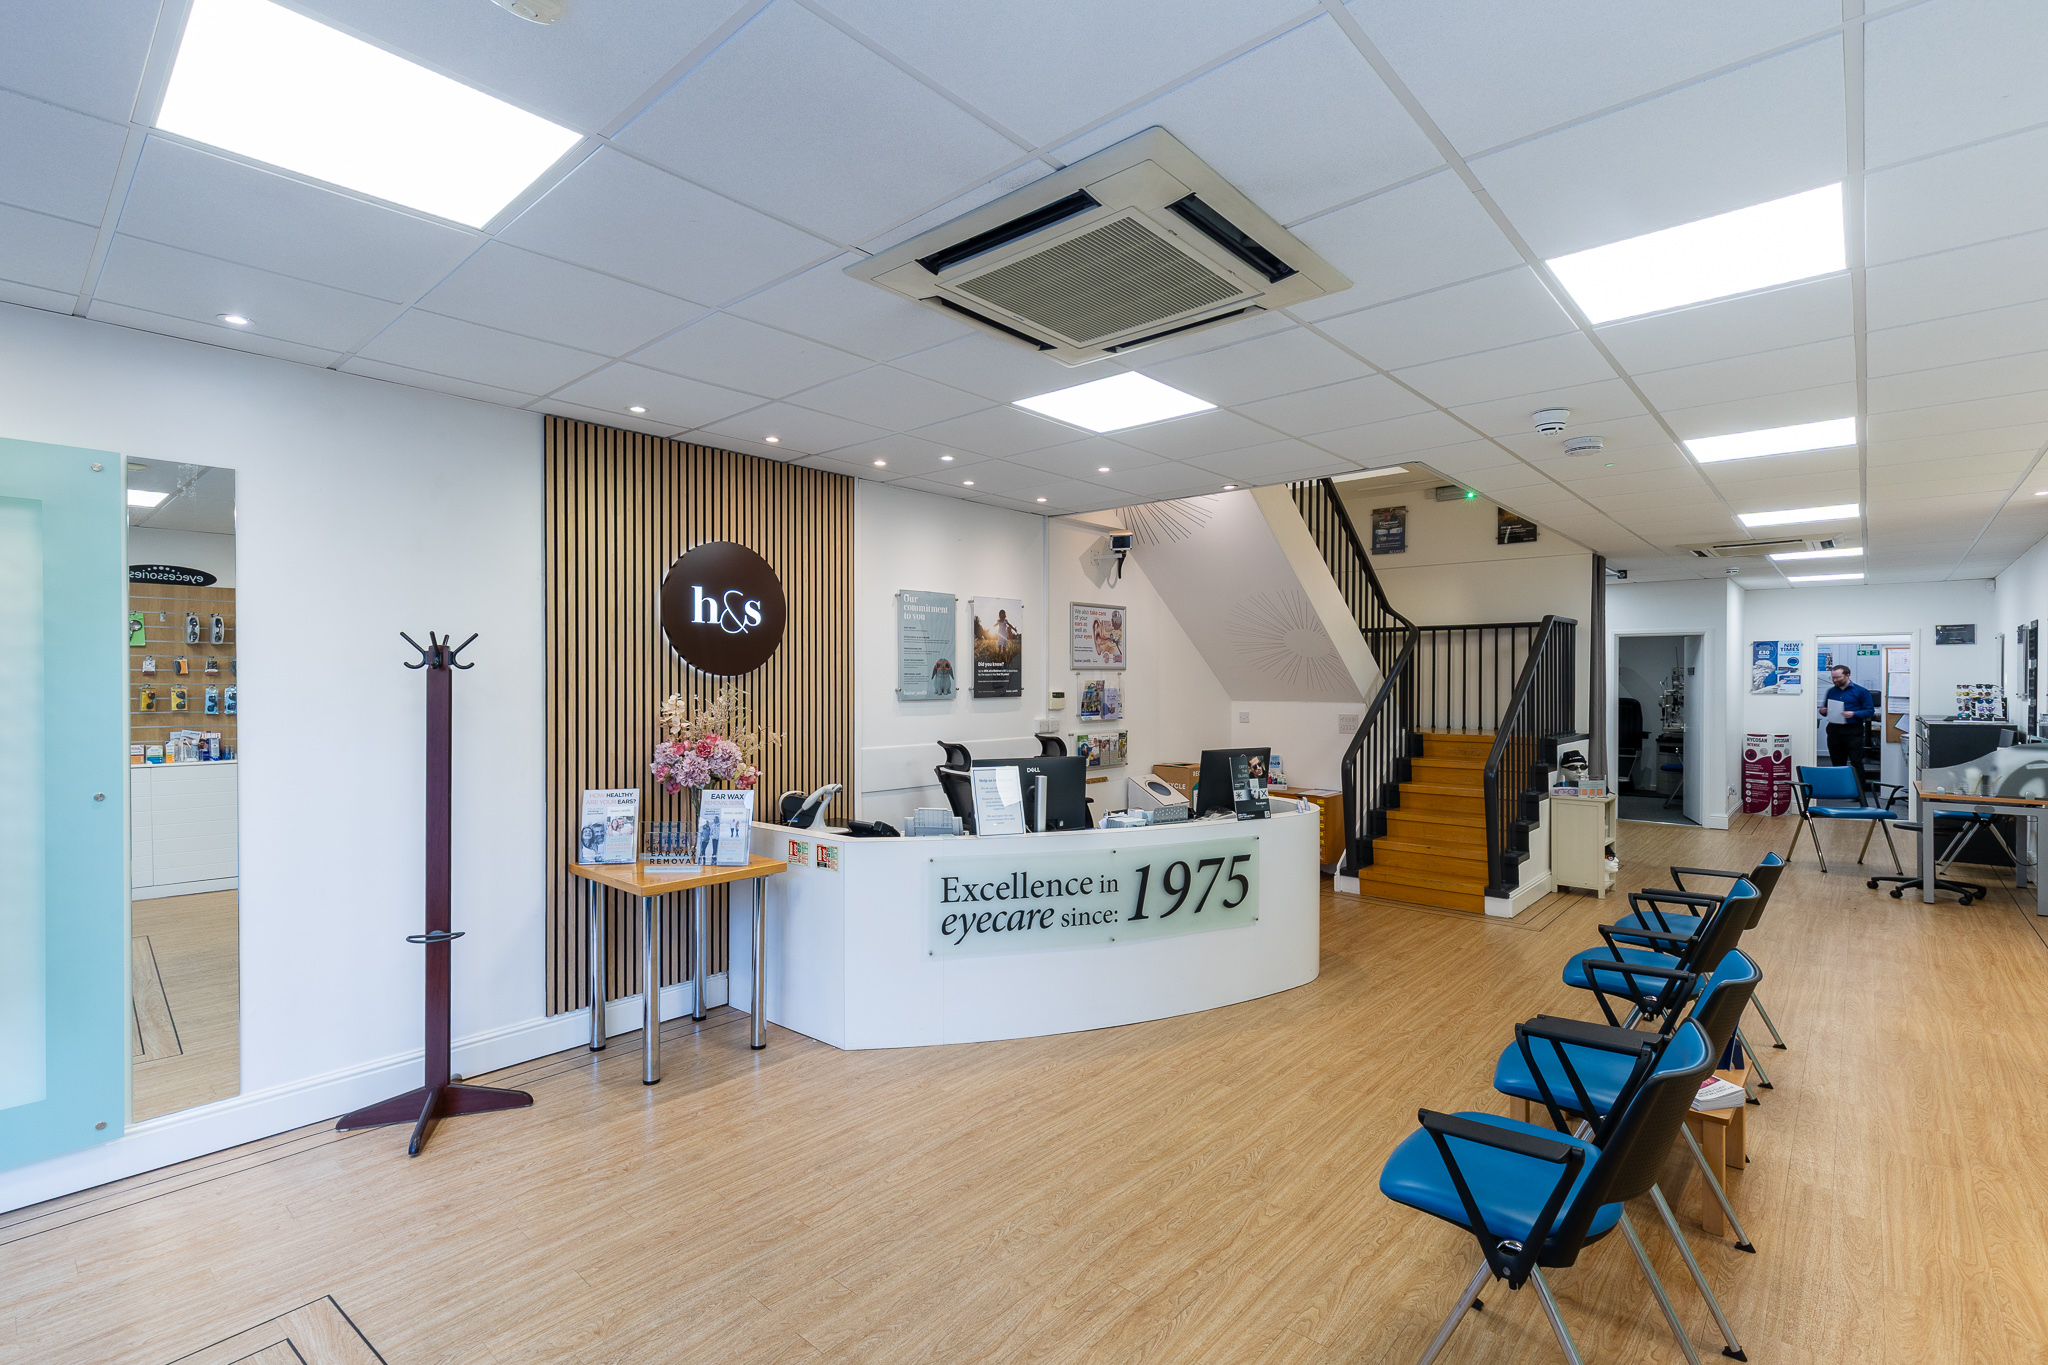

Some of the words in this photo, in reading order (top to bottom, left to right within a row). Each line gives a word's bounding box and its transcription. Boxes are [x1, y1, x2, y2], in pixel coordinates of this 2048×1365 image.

[903, 593, 919, 603] Our
[691, 585, 762, 634] h&s
[903, 604, 949, 614] commitment
[903, 612, 911, 620] to
[912, 613, 926, 621] you
[1168, 782, 1186, 790] YCLE
[940, 871, 1093, 904] Excellence
[1099, 874, 1119, 894] in
[941, 907, 1055, 946] eyecare
[1060, 907, 1118, 928] since:
[1127, 854, 1252, 922] 1975
